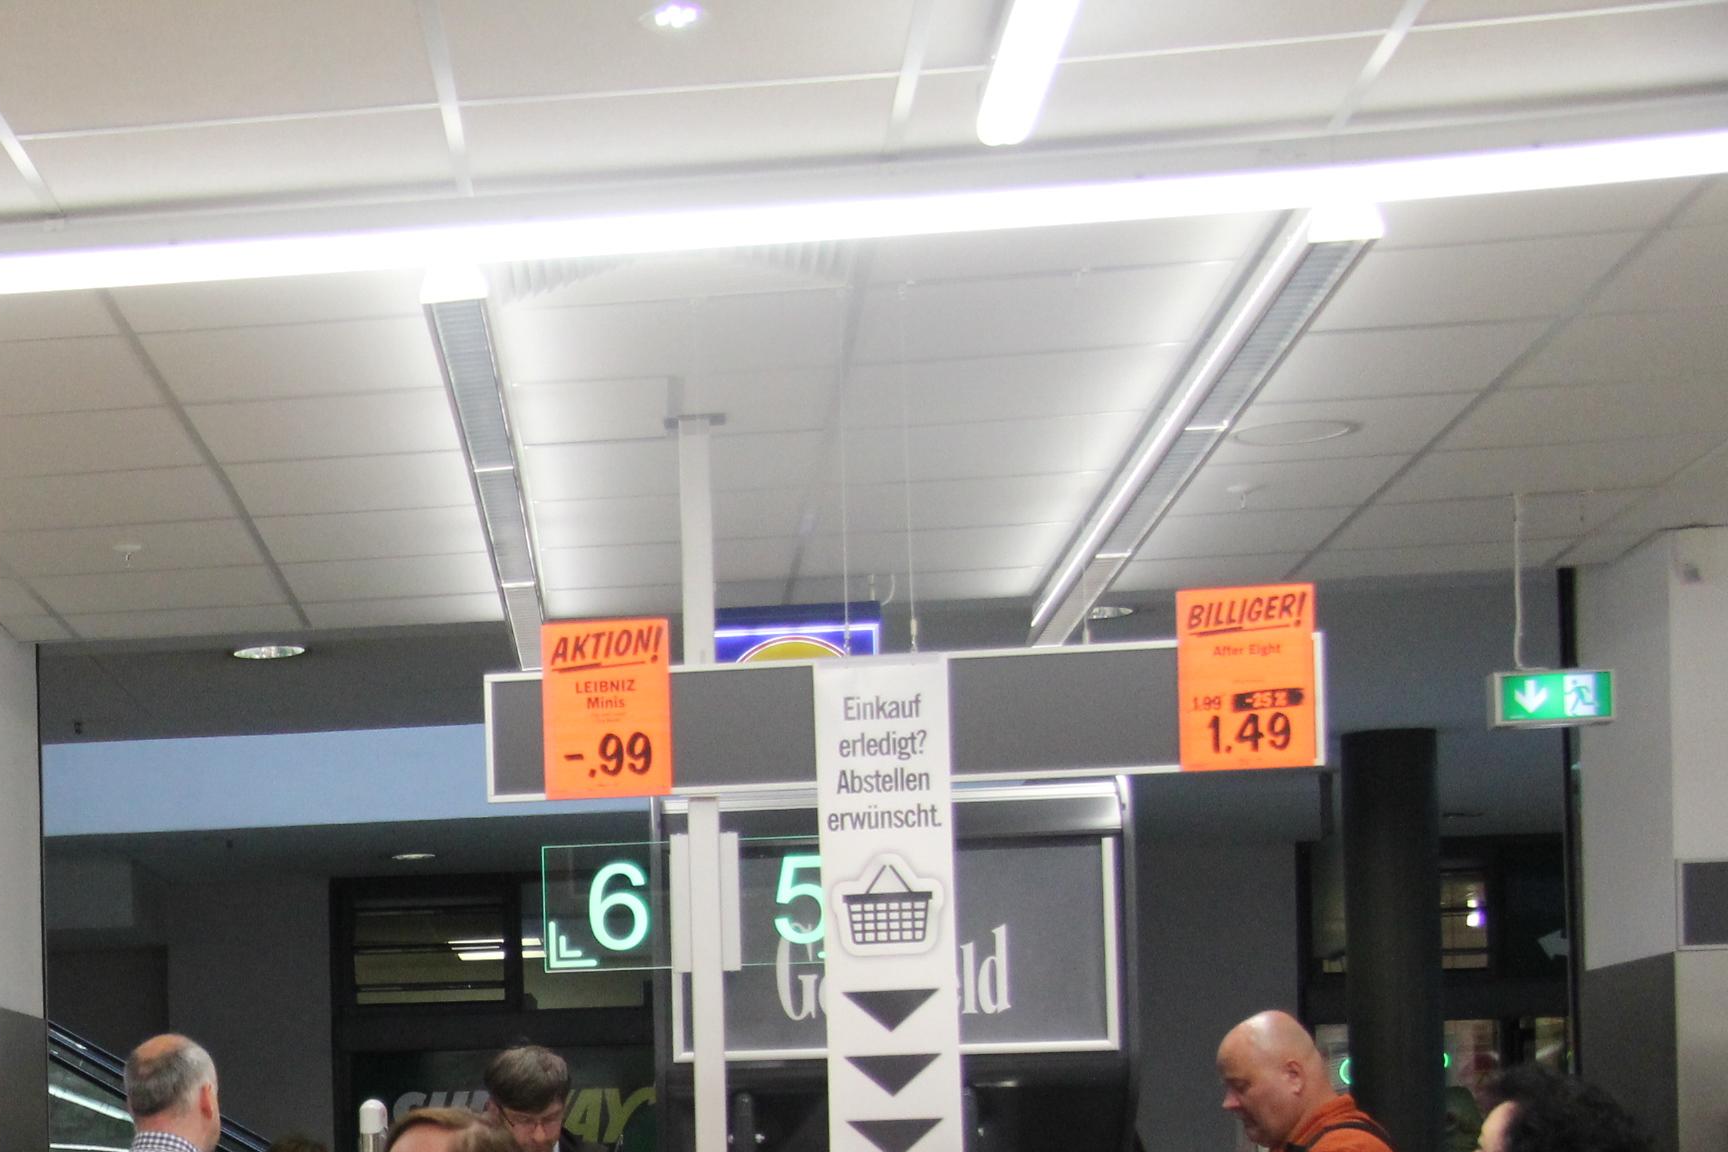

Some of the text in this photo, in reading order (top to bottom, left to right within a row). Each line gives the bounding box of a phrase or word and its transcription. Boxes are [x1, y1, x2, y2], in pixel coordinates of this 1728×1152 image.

[1186, 591, 1307, 631] BILLIGER!
[550, 625, 663, 666] AKTION!
[1213, 642, 1282, 657] After Eight
[575, 679, 636, 695] LEIBNIZ
[587, 696, 625, 709] Minis
[842, 693, 922, 721] Einkauf
[1192, 695, 1223, 711] 1.99
[838, 729, 928, 761] erledigt?
[1207, 711, 1292, 754] 1.49
[563, 731, 653, 779] -.99
[835, 767, 931, 795] Abstellen
[827, 802, 943, 832] erwünscht.
[588, 862, 651, 951] 6
[775, 854, 825, 944] 5
